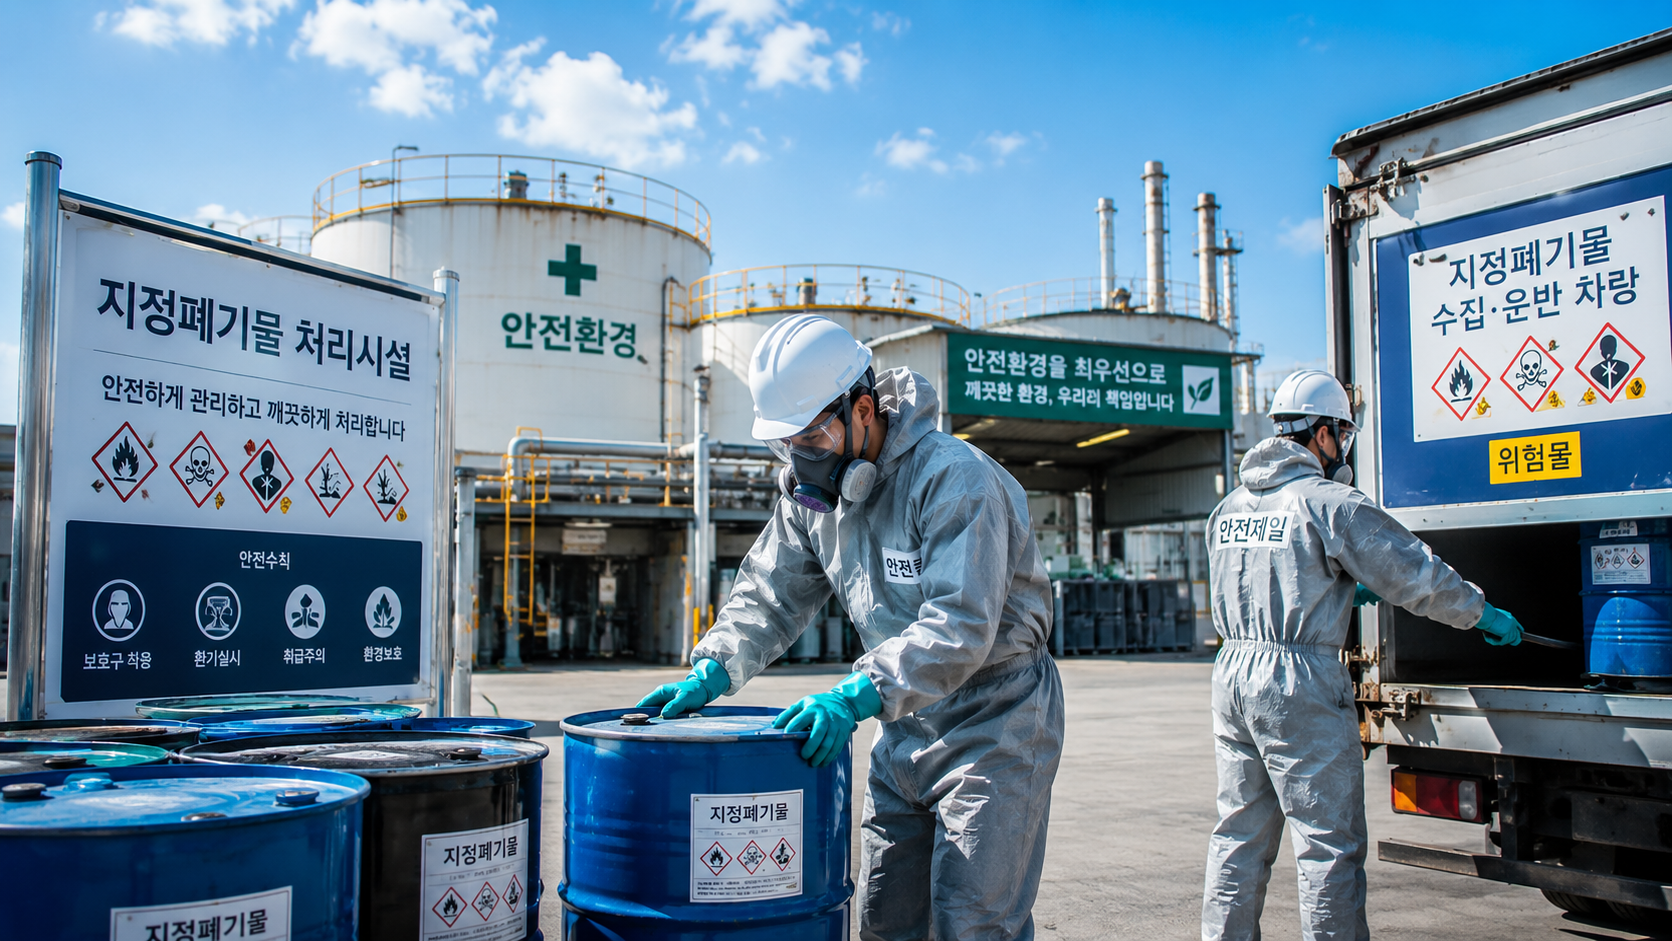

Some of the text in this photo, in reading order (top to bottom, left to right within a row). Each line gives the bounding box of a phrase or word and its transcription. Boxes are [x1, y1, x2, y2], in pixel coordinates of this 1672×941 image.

[1449, 225, 1612, 290] 지정폐기물
[1575, 266, 1640, 309] 차랑
[98, 278, 284, 357] 지정폐기물
[501, 312, 637, 359] 안전환경
[964, 348, 1167, 384] 안전환경을 최우선으로
[101, 375, 406, 442] 안전하게 관리하고 깨끗하게 처리합니다
[1498, 441, 1573, 474] 위험물
[1219, 516, 1288, 544] 안전제일
[239, 550, 290, 571] 안전수칙
[83, 651, 152, 670] 보호구 착용
[194, 649, 241, 668] 환기실시
[283, 647, 326, 665] 취급주의
[363, 645, 403, 663] 환경보호
[710, 802, 789, 824] 지정폐기물
[443, 835, 518, 867] 지정폐기물
